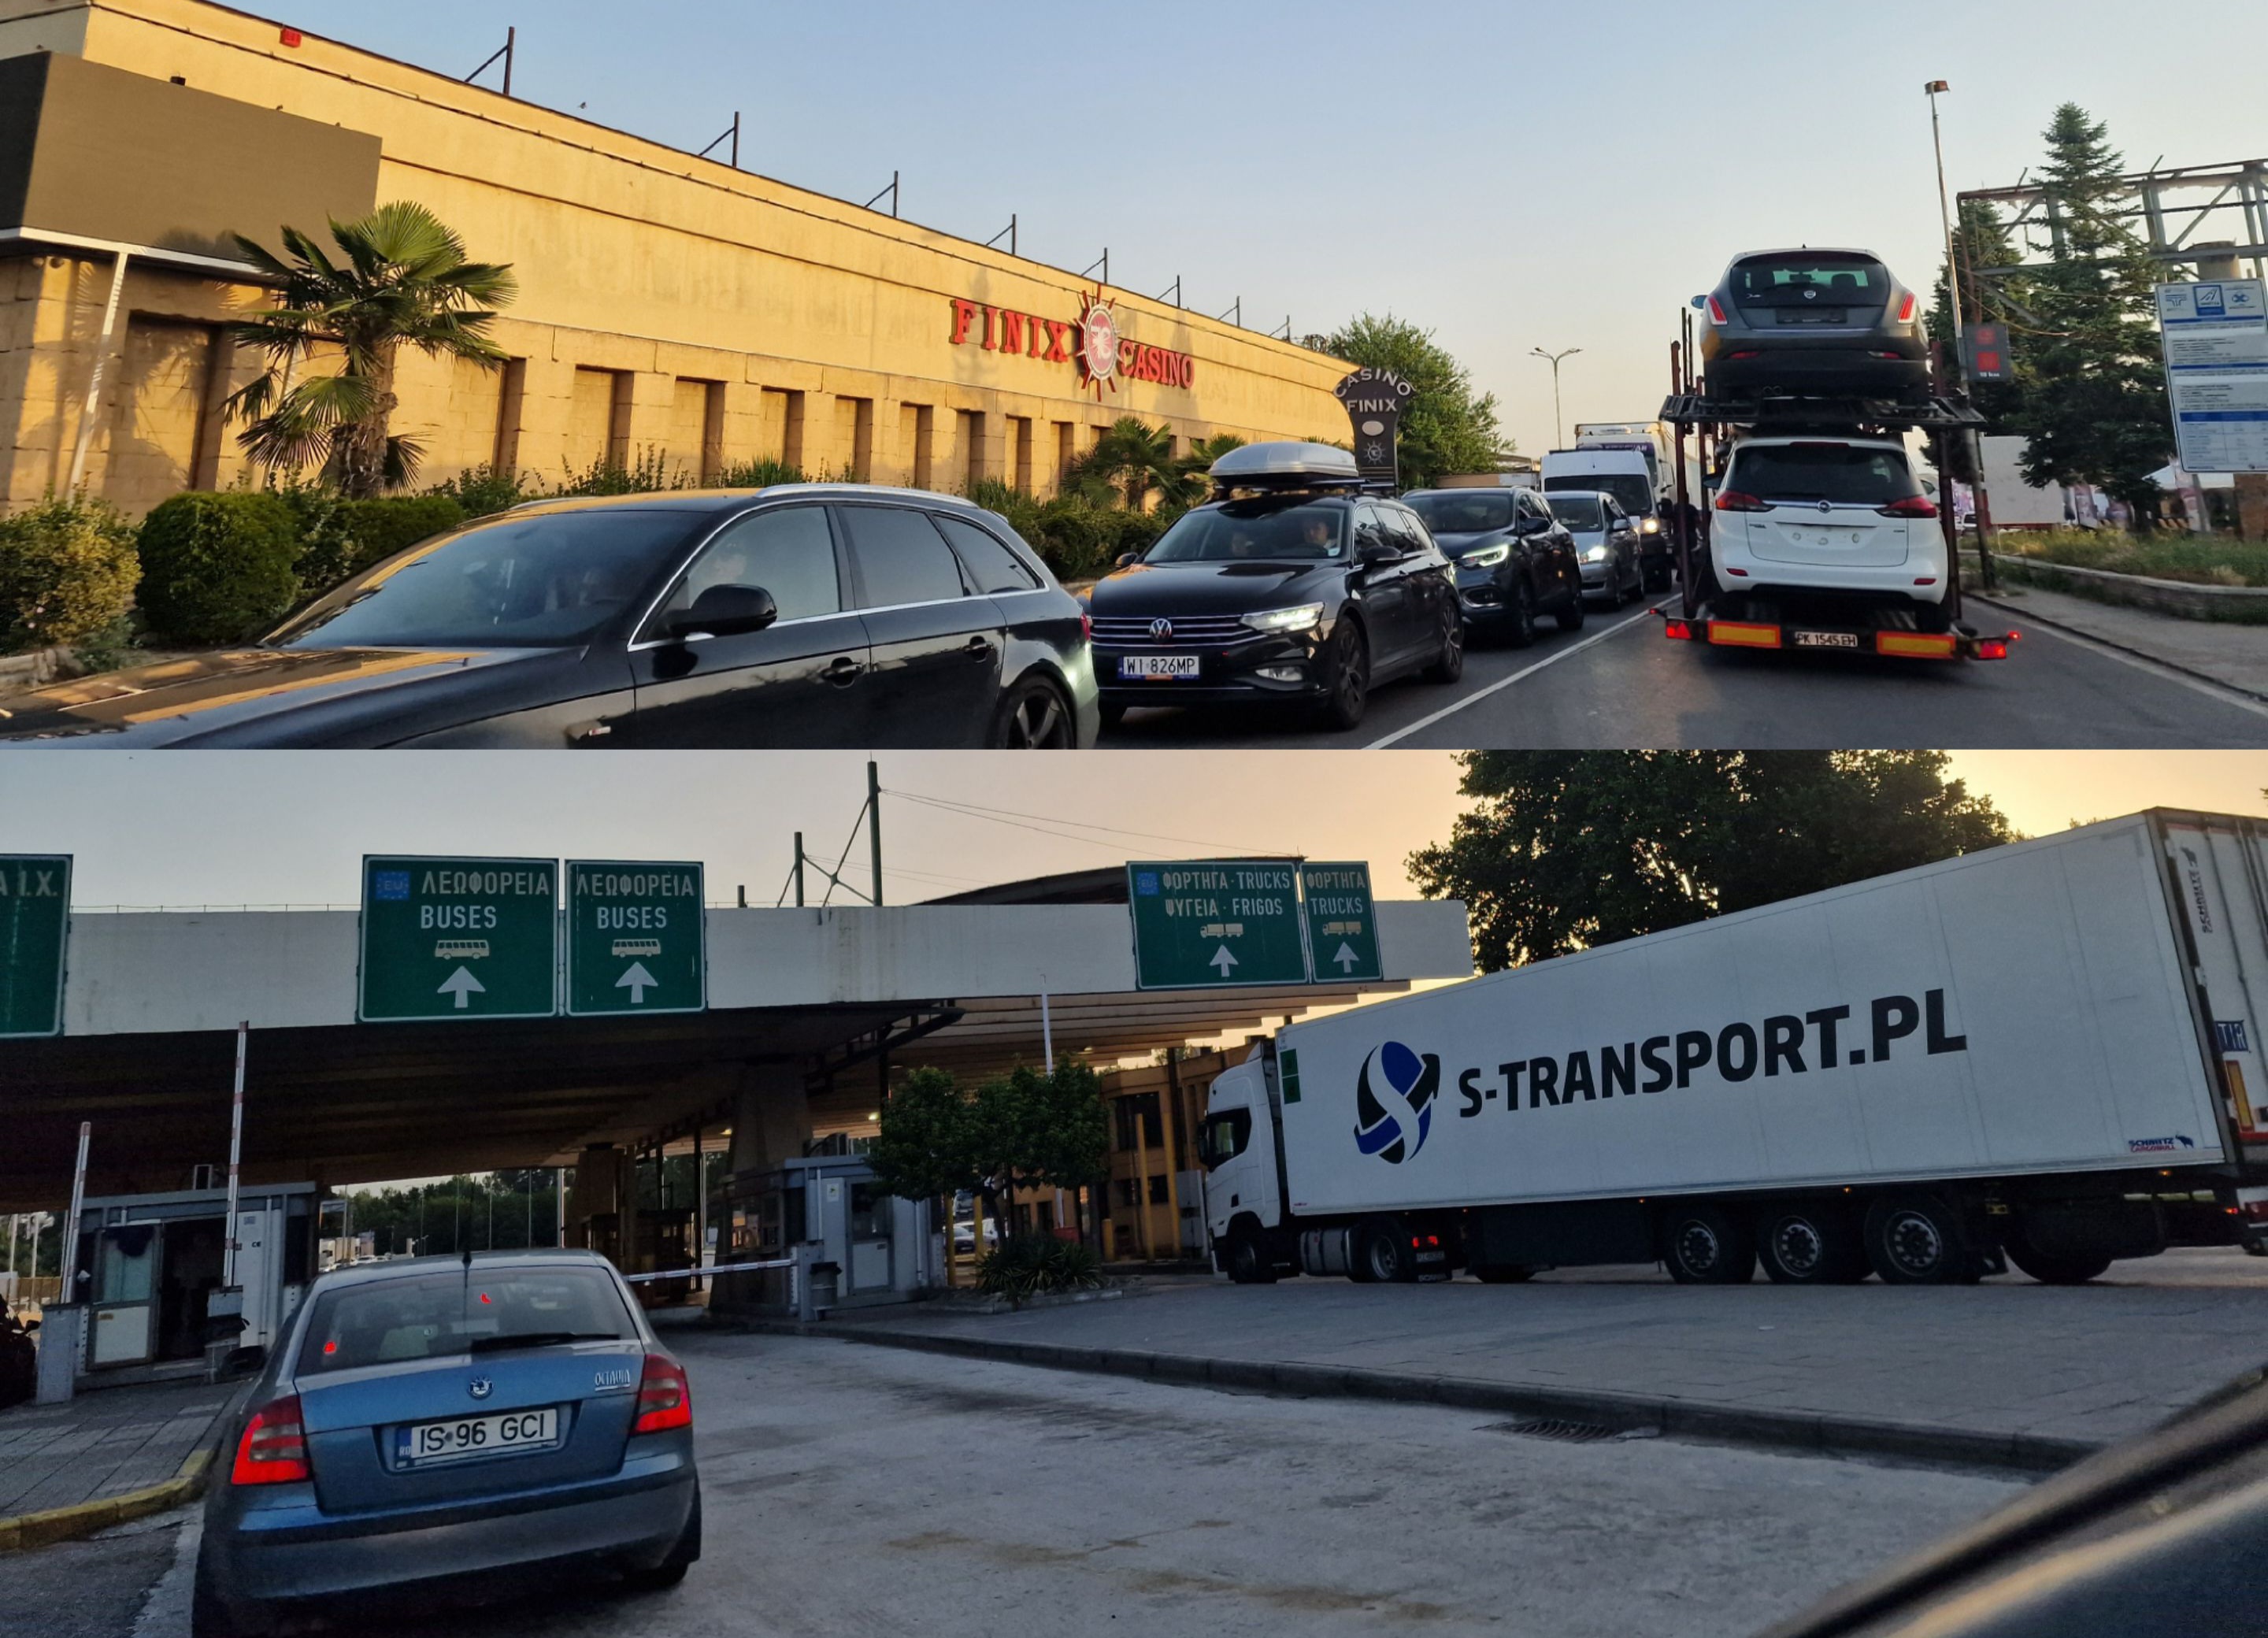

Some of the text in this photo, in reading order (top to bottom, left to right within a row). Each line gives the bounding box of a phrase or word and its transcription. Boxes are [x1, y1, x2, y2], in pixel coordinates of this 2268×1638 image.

[950, 298, 1069, 362] FINIX
[1117, 339, 1195, 389] CASINO
[1332, 368, 1411, 398] CASINO
[1347, 398, 1397, 413] FINIX
[1126, 658, 1195, 674] WI 826MP
[421, 871, 550, 896] ΛΕΩΦΟΡΕΙΑ
[576, 873, 695, 897] ΛΕΩΦΟΡΕΙΑ
[1162, 872, 1228, 890] ΦΟΡΤΗΓΑ
[1236, 872, 1291, 890] TRUCKS
[1306, 871, 1366, 889] ΦΟΡΤΗΓΑ
[421, 906, 497, 929] BUSES
[597, 906, 667, 929] BUSES
[1165, 899, 1219, 917] ΨΥΓΕΙΑ
[1232, 899, 1284, 916] FRIGOS
[1310, 898, 1363, 916] TRUCKS
[2217, 1023, 2247, 1050] TIR
[1458, 988, 1967, 1118] S-TRANSPORT.PL
[420, 1413, 545, 1454] IS 96 GCI
